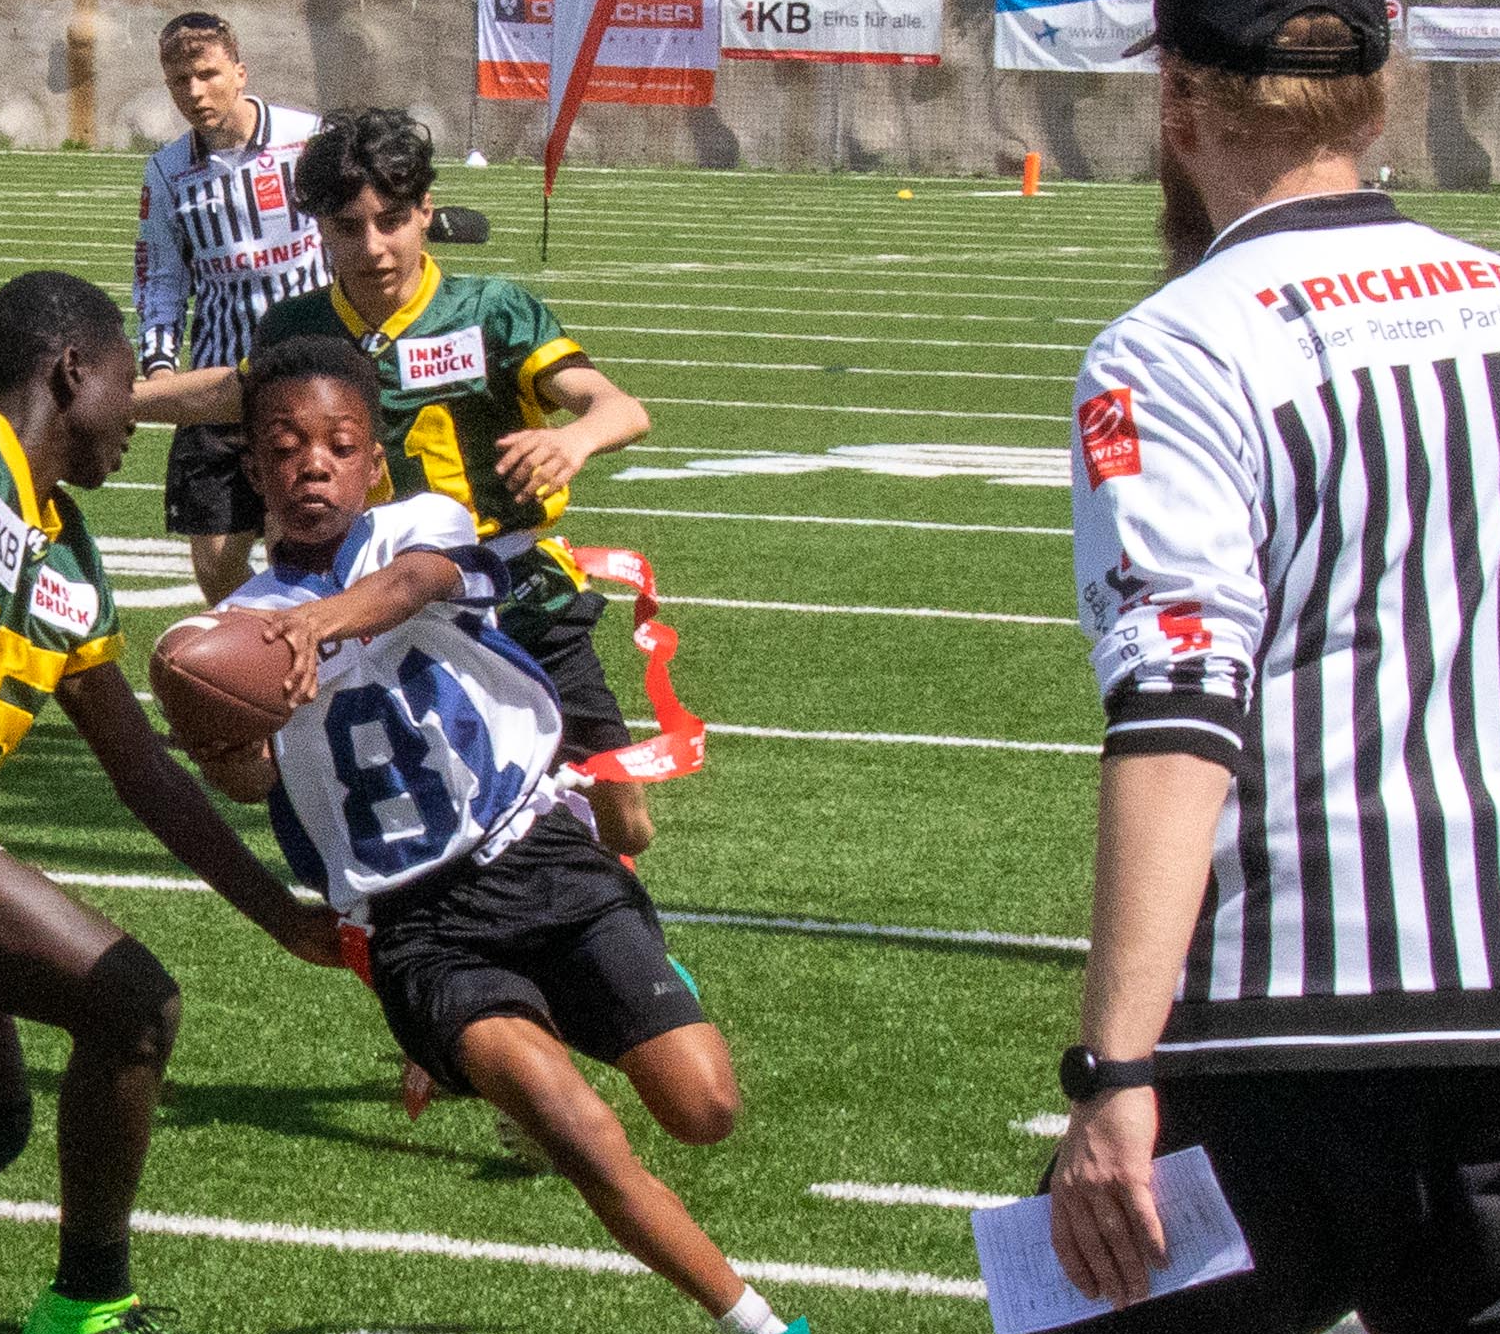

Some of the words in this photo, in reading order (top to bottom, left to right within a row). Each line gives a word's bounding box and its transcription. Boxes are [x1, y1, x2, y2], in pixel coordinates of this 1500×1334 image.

[530, 0, 695, 22] OCHER
[740, 1, 812, 34] iKB
[823, 10, 859, 28] Eins
[865, 10, 888, 28] für
[892, 12, 926, 29] alle.
[210, 234, 318, 275] RICHNER
[1367, 318, 1445, 341] Platten
[410, 354, 475, 380] BRUCK
[34, 591, 90, 627] BRUCK
